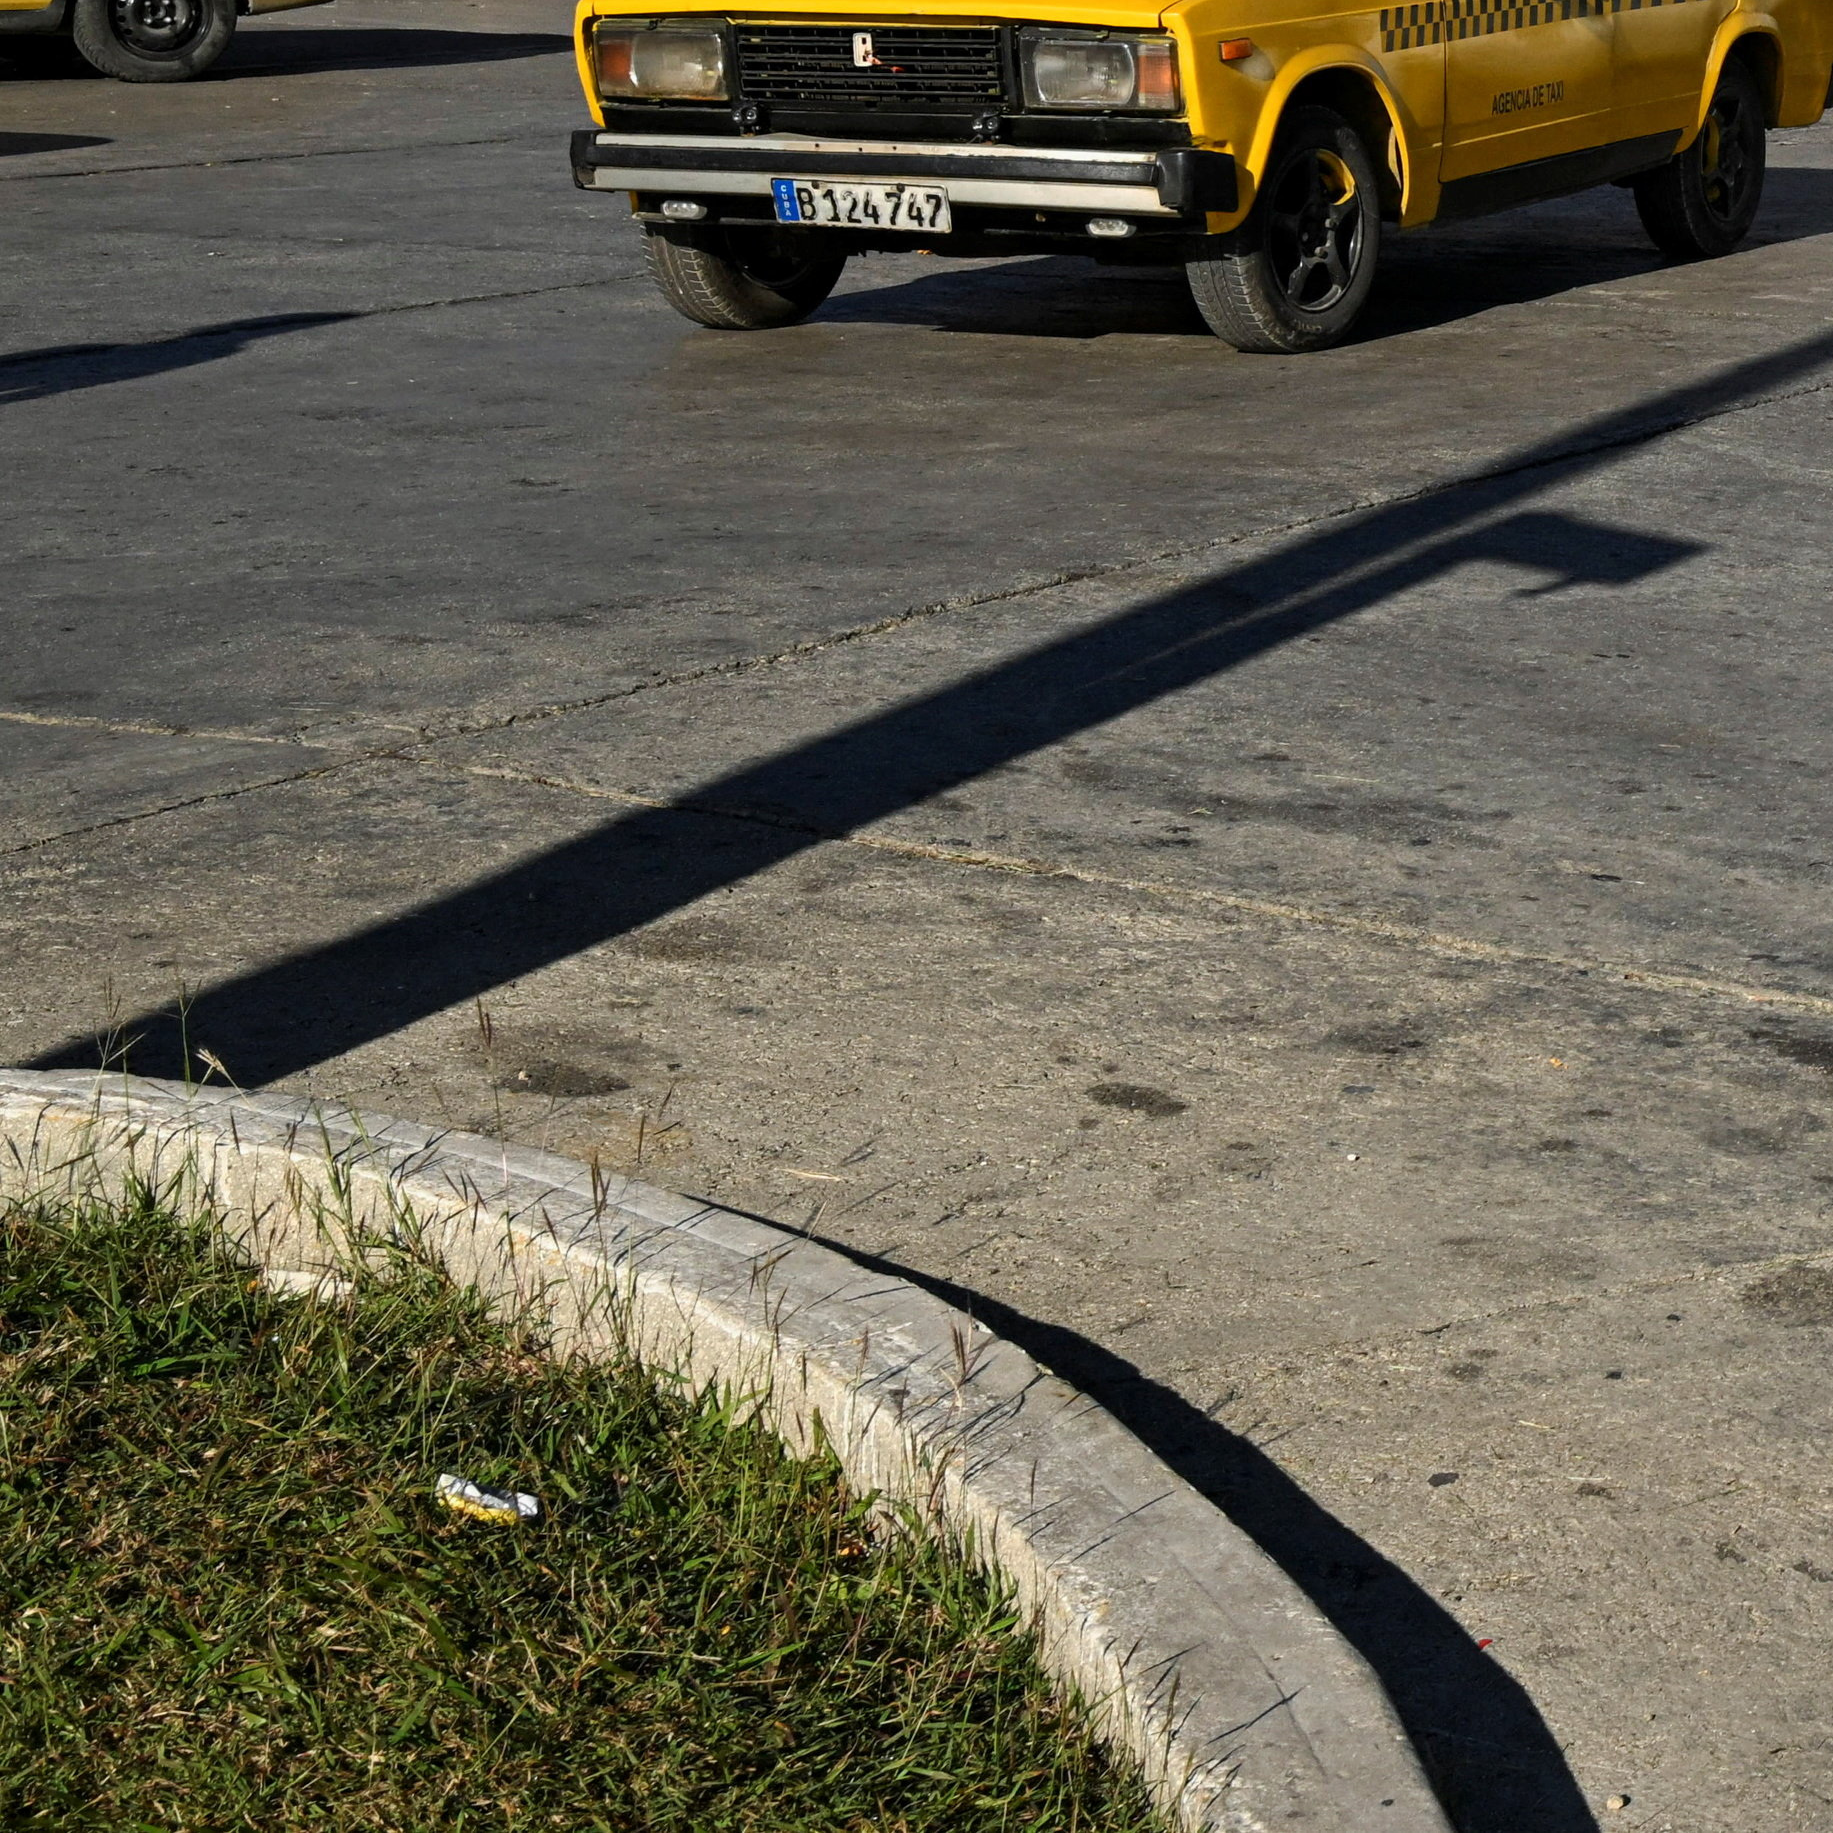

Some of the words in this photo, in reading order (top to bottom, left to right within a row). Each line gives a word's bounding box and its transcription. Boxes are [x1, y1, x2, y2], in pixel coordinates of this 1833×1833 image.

[1491, 88, 1531, 115] AGENCIA
[1533, 84, 1545, 107] DE
[1546, 79, 1564, 104] TAXI
[780, 184, 792, 217] CUBA
